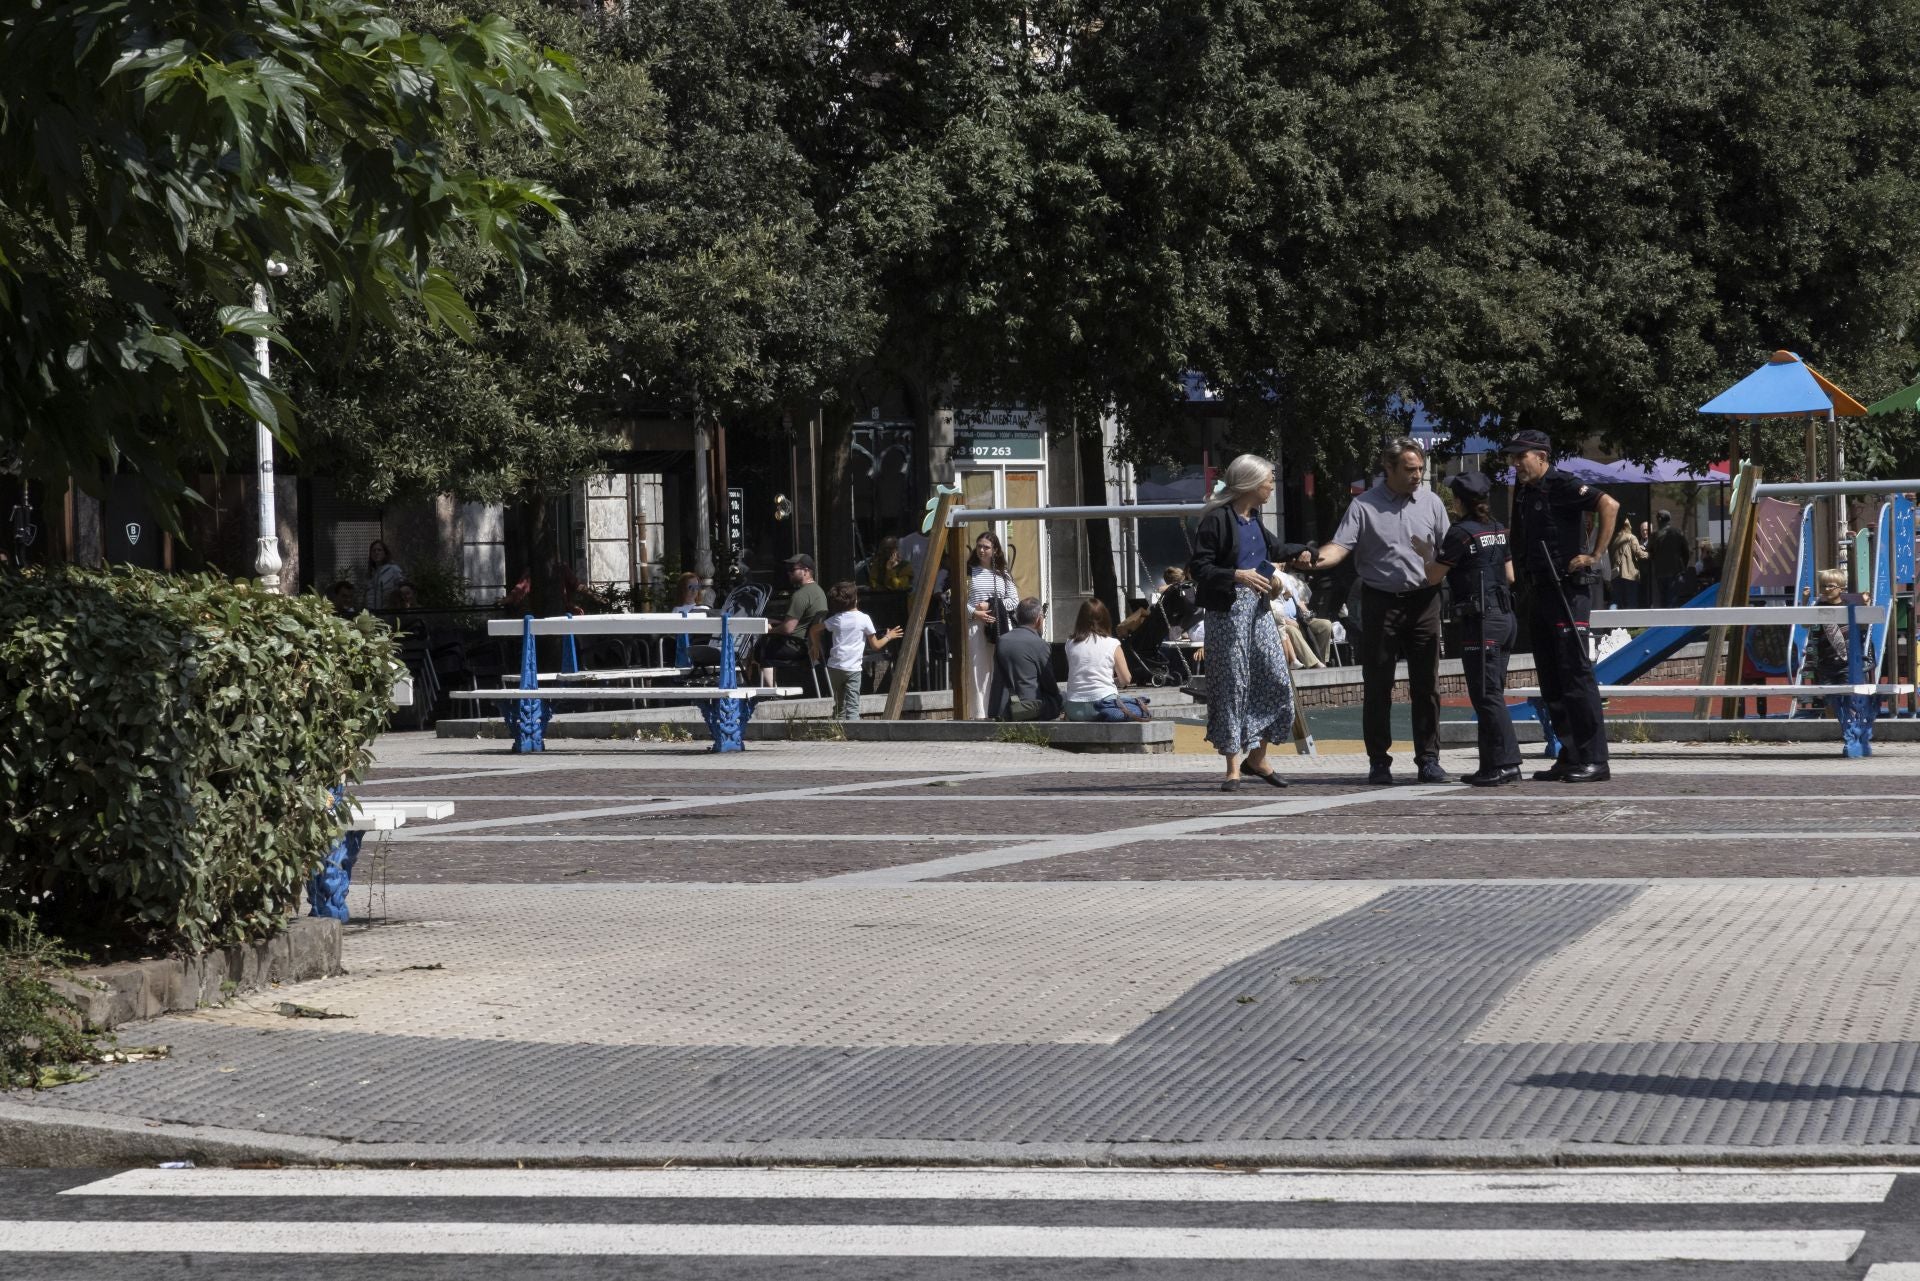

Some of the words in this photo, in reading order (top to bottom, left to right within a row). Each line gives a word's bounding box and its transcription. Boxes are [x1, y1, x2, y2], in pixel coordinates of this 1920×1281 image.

[969, 446, 989, 456] 907
[991, 446, 1012, 456] 263
[130, 526, 136, 535] B
